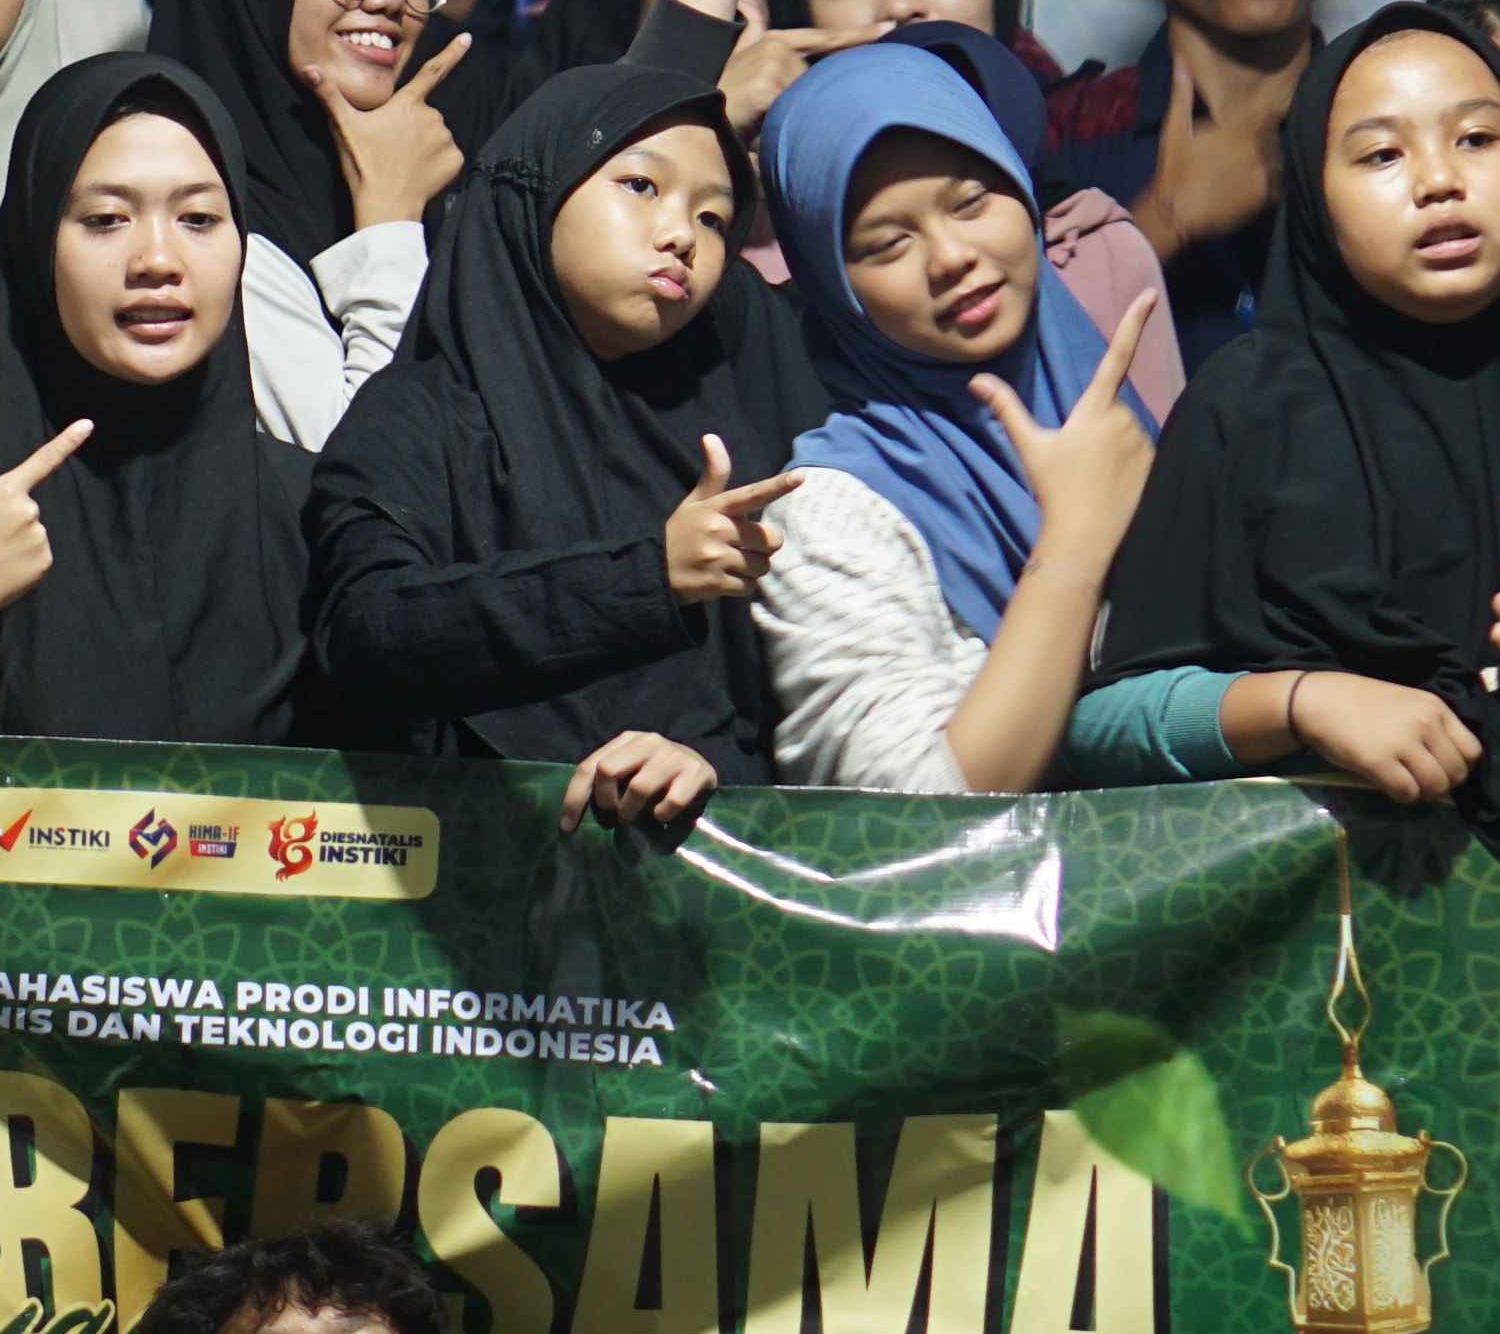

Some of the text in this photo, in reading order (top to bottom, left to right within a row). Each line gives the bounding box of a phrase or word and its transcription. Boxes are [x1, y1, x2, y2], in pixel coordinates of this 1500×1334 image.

[29, 826, 110, 848] INSTIKI
[189, 825, 240, 841] HIMA-IF
[320, 831, 423, 847] DIESNATALIS
[319, 845, 407, 866] INSTIKI
[236, 981, 369, 1016] PRODI
[384, 987, 676, 1031] INFORMATIKA
[67, 1009, 162, 1042] DAN
[175, 1015, 419, 1053] TEKNOLOGI
[432, 1024, 663, 1066] INDONESIA
